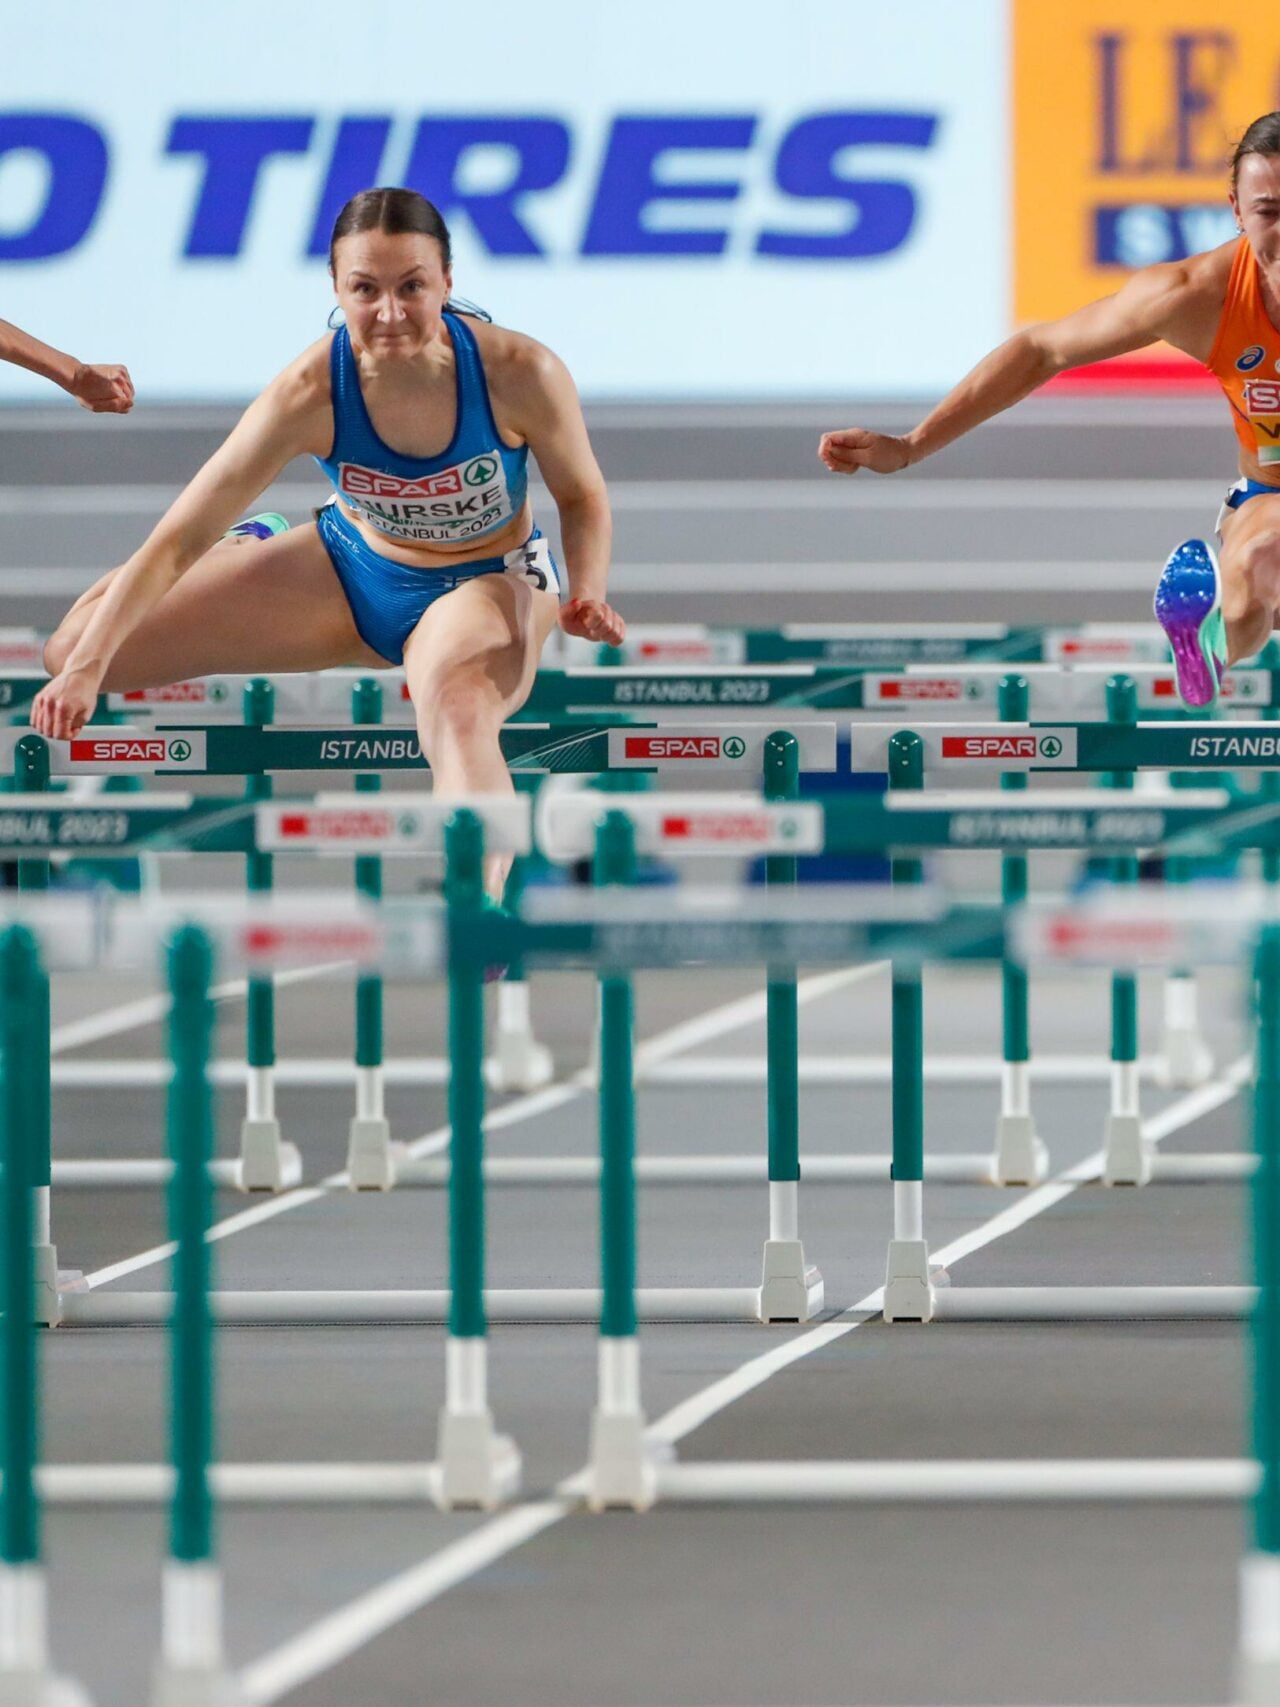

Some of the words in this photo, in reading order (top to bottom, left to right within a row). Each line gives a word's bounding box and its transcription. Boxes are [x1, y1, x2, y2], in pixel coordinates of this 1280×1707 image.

[1097, 29, 1238, 174] LE
[165, 112, 936, 259] TIRES
[343, 470, 459, 497] SPAR
[459, 507, 502, 537] 2023
[614, 681, 715, 701] ISTANBUL
[719, 681, 770, 701] 2023
[93, 743, 164, 759] SPAR
[320, 740, 422, 759] ISTANBU
[648, 740, 718, 756] SPAR
[965, 739, 1035, 755] SPAR
